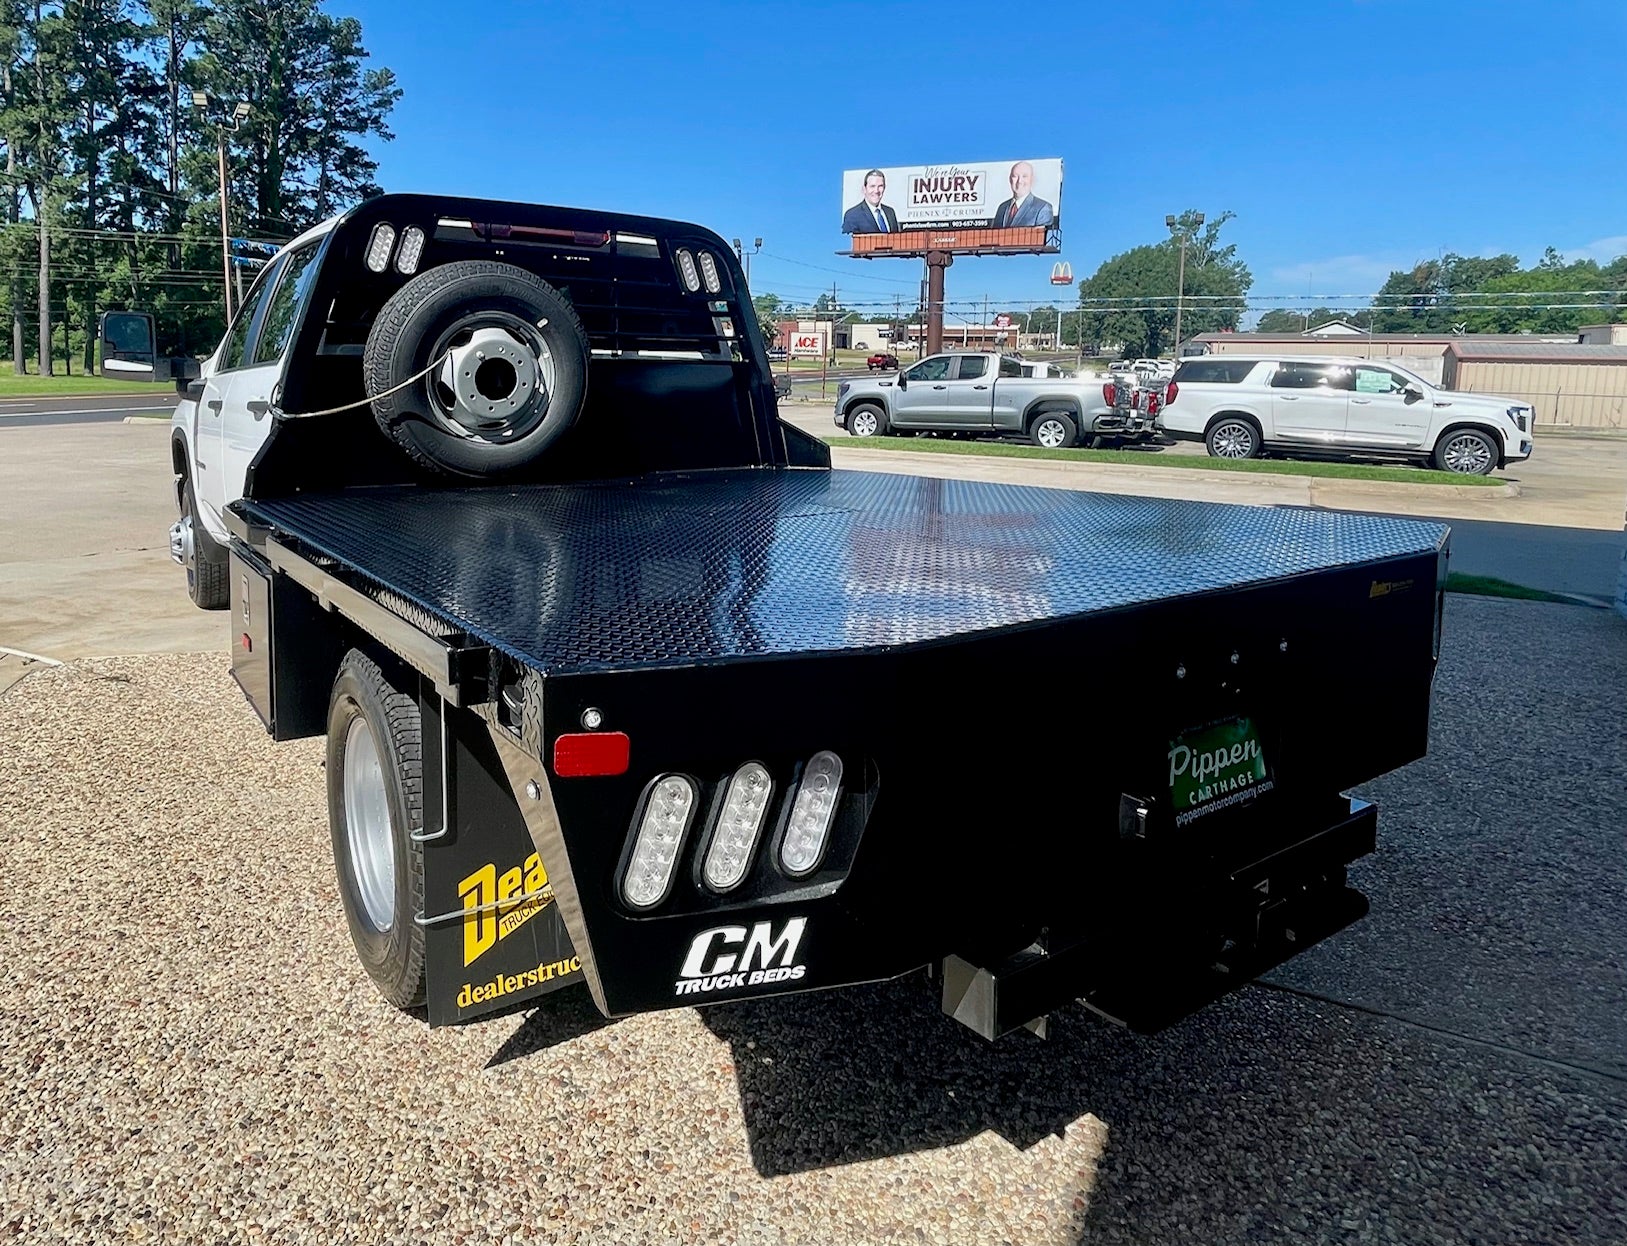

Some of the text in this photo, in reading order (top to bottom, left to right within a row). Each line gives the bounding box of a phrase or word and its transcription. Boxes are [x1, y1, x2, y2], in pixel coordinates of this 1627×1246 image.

[913, 192, 978, 204] LAWYERS
[914, 175, 979, 193] INJURY
[907, 208, 985, 218] PHENIX CRUMP
[795, 336, 819, 347] ACE
[1167, 738, 1262, 787] Pippen
[1189, 771, 1254, 805] CARTHAGE
[1175, 780, 1274, 829] pippenmotorcompany.com
[501, 900, 538, 933] TRUCK
[679, 916, 809, 978] CM
[674, 965, 807, 996] TRUCK BEDS
